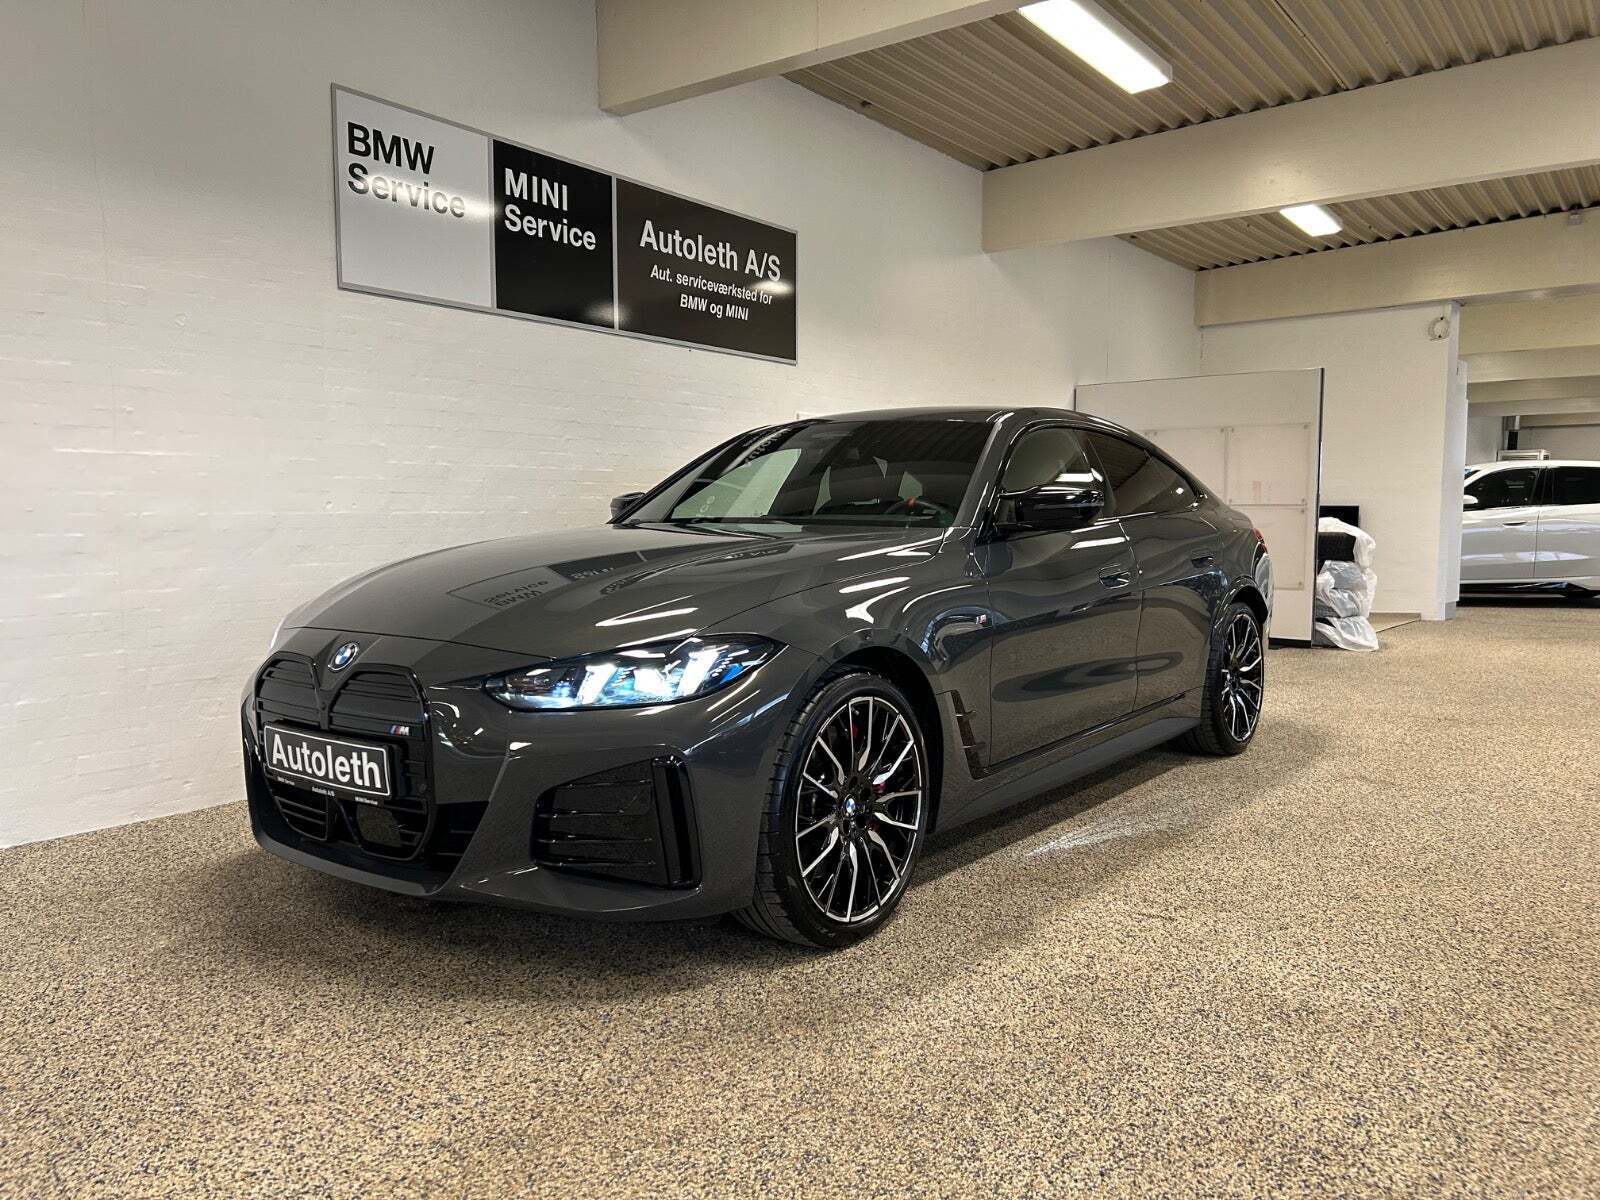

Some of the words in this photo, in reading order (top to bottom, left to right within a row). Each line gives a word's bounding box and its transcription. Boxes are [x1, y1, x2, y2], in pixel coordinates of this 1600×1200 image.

[347, 121, 435, 175] BMW
[347, 162, 466, 218] Service
[504, 167, 568, 212] MINI
[504, 203, 597, 251] Service
[639, 219, 738, 272] Autoleth
[744, 248, 782, 283] A/S
[650, 264, 674, 283] Aut.
[675, 272, 758, 302] serviceværksted
[759, 289, 773, 306] for
[679, 293, 708, 312] BMW
[709, 302, 723, 319] og
[725, 303, 749, 321] MINI
[272, 733, 382, 789] Autoleth
